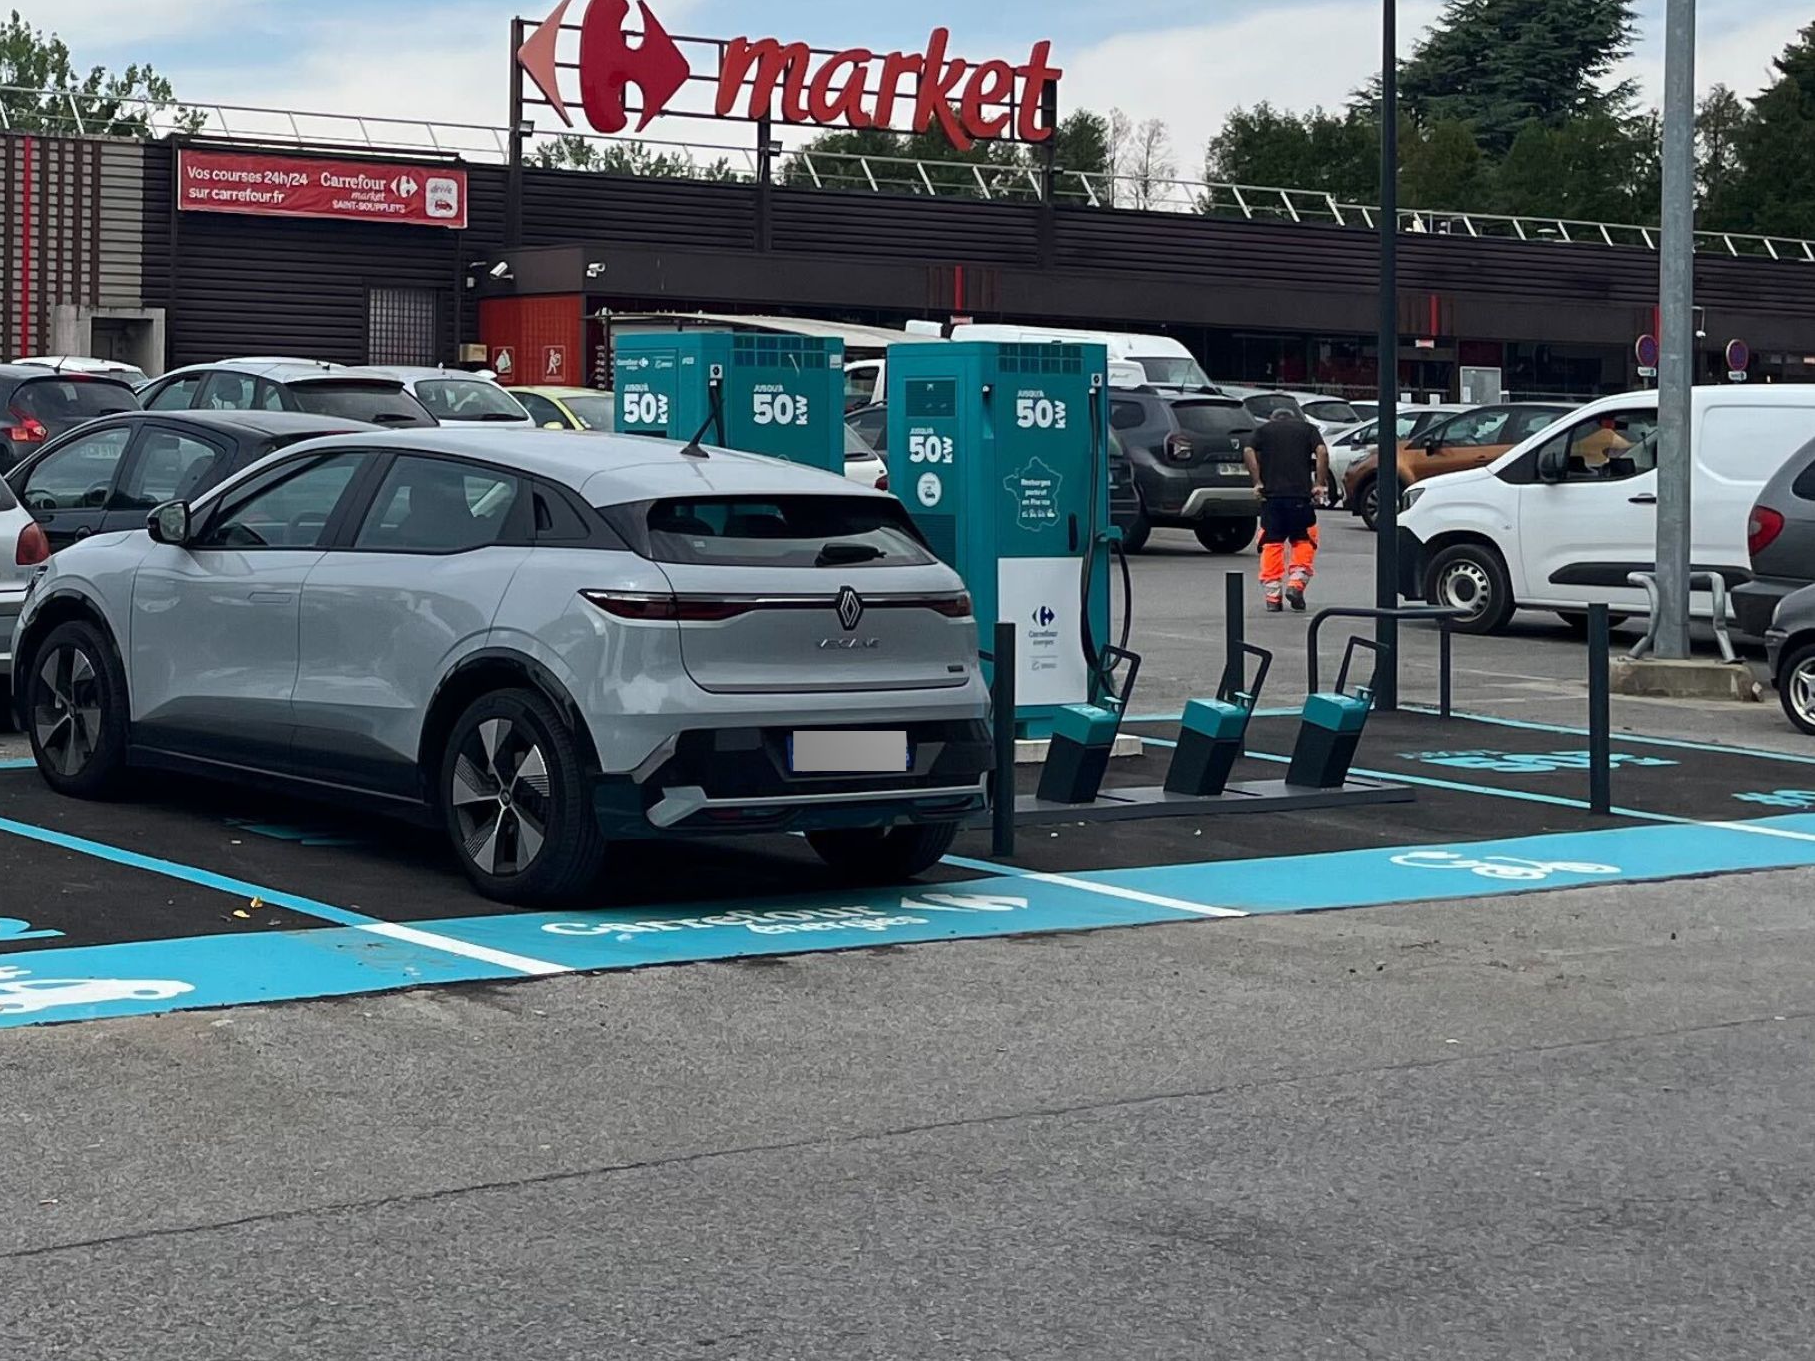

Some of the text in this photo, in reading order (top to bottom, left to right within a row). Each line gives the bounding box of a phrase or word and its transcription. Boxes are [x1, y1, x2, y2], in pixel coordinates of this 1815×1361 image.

[716, 27, 1062, 151] market
[187, 166, 308, 187] Vos courses 24h/24
[320, 172, 386, 190] Carrefour
[189, 187, 284, 204] sur carrefour.fr
[332, 200, 406, 214] SAINT-SOUPPLETS
[351, 190, 385, 202] market
[623, 392, 669, 424] 50 kW
[753, 393, 808, 425] 50 kW
[1016, 399, 1066, 429] 50 kW
[909, 435, 953, 464] 50 kW
[541, 905, 887, 936] Carrefour
